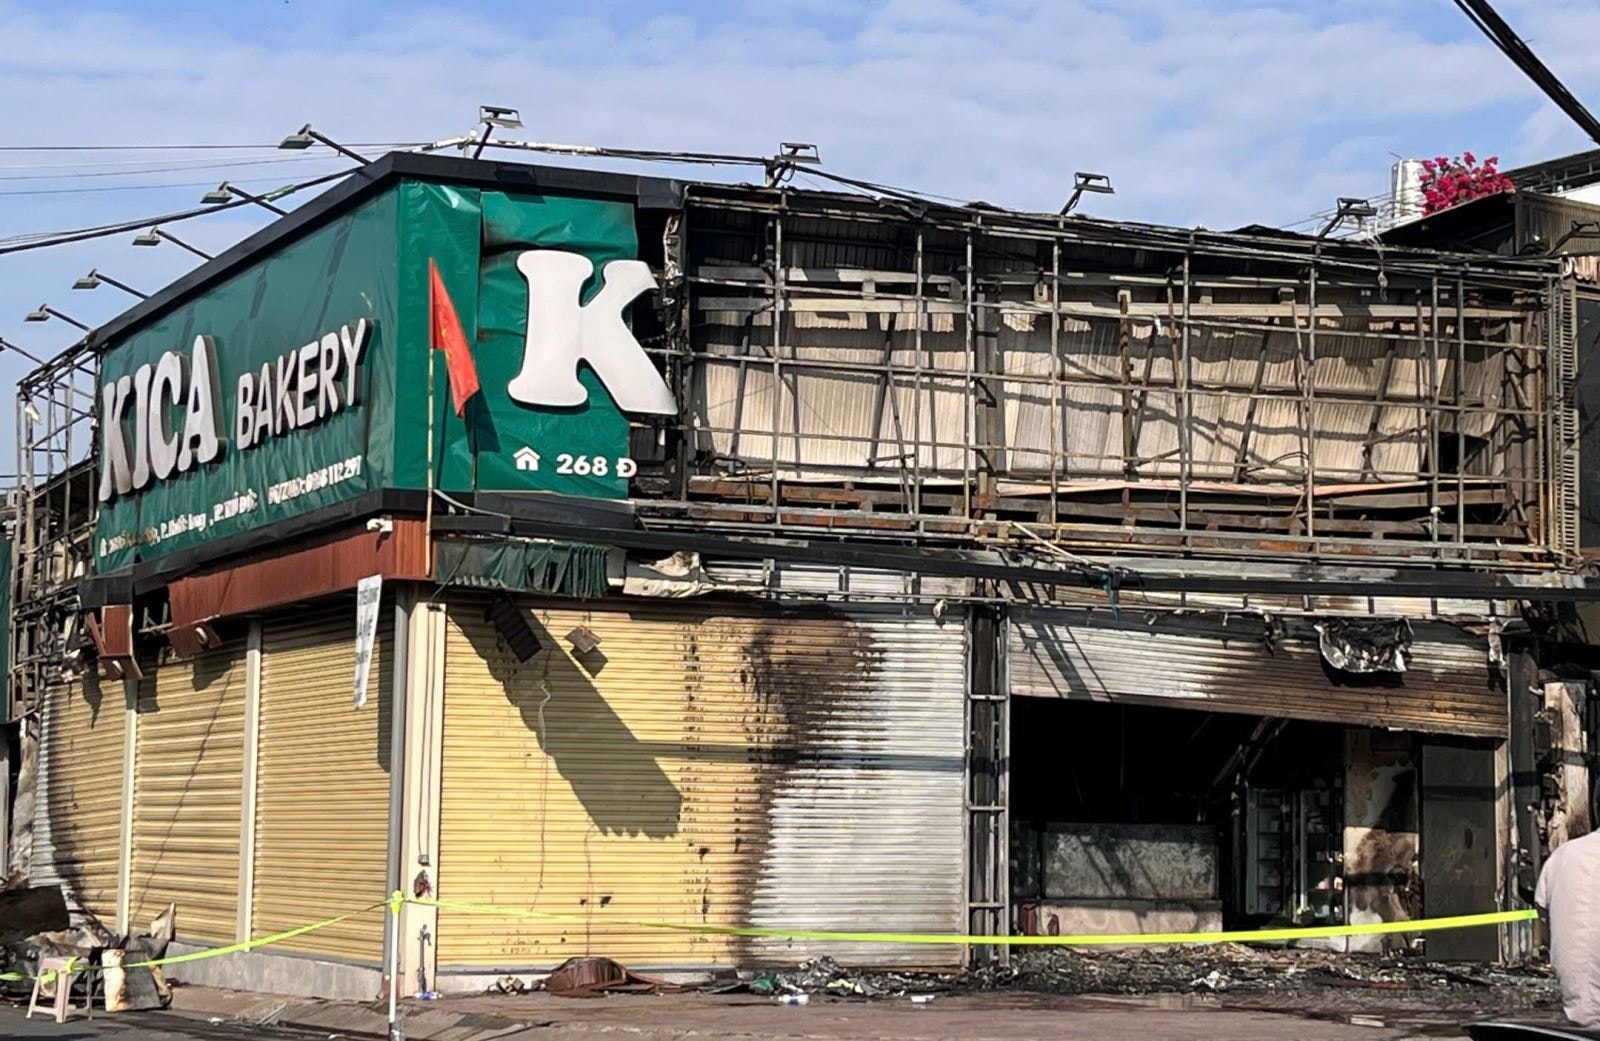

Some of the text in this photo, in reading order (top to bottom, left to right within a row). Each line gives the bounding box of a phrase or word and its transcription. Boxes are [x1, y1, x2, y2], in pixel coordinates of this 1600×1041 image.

[99, 318, 367, 501] KICA BAKERY
[508, 251, 678, 415] K
[556, 453, 608, 476] 268
